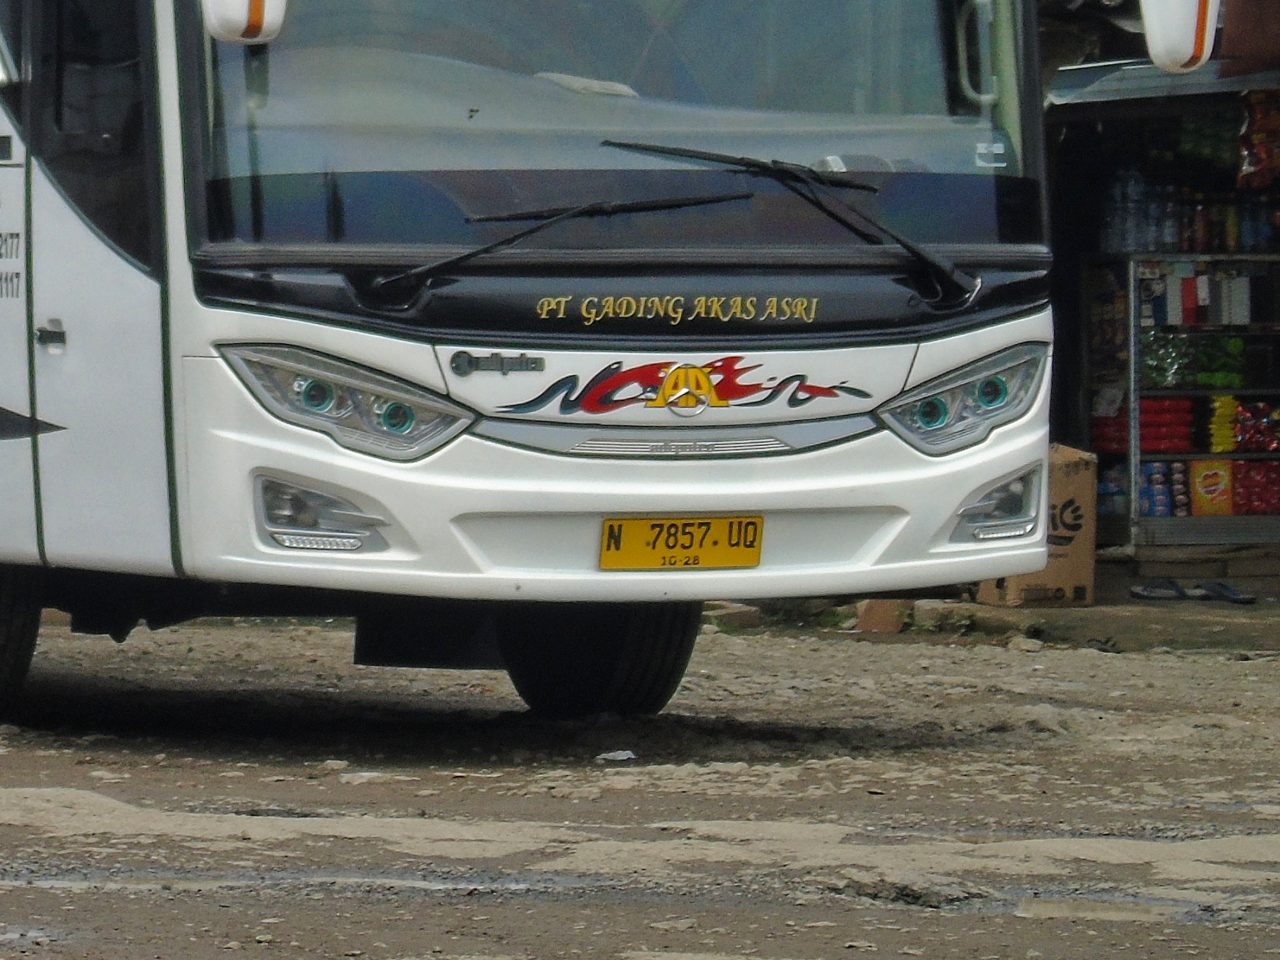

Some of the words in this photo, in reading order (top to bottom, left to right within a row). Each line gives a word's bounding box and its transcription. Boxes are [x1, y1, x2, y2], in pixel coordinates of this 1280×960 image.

[537, 296, 572, 319] PT
[581, 295, 685, 325] GADING
[688, 296, 757, 322] AKAS
[760, 297, 819, 323] ASRI
[606, 524, 623, 551] N
[650, 522, 712, 550] 7857
[728, 521, 758, 548] UQ
